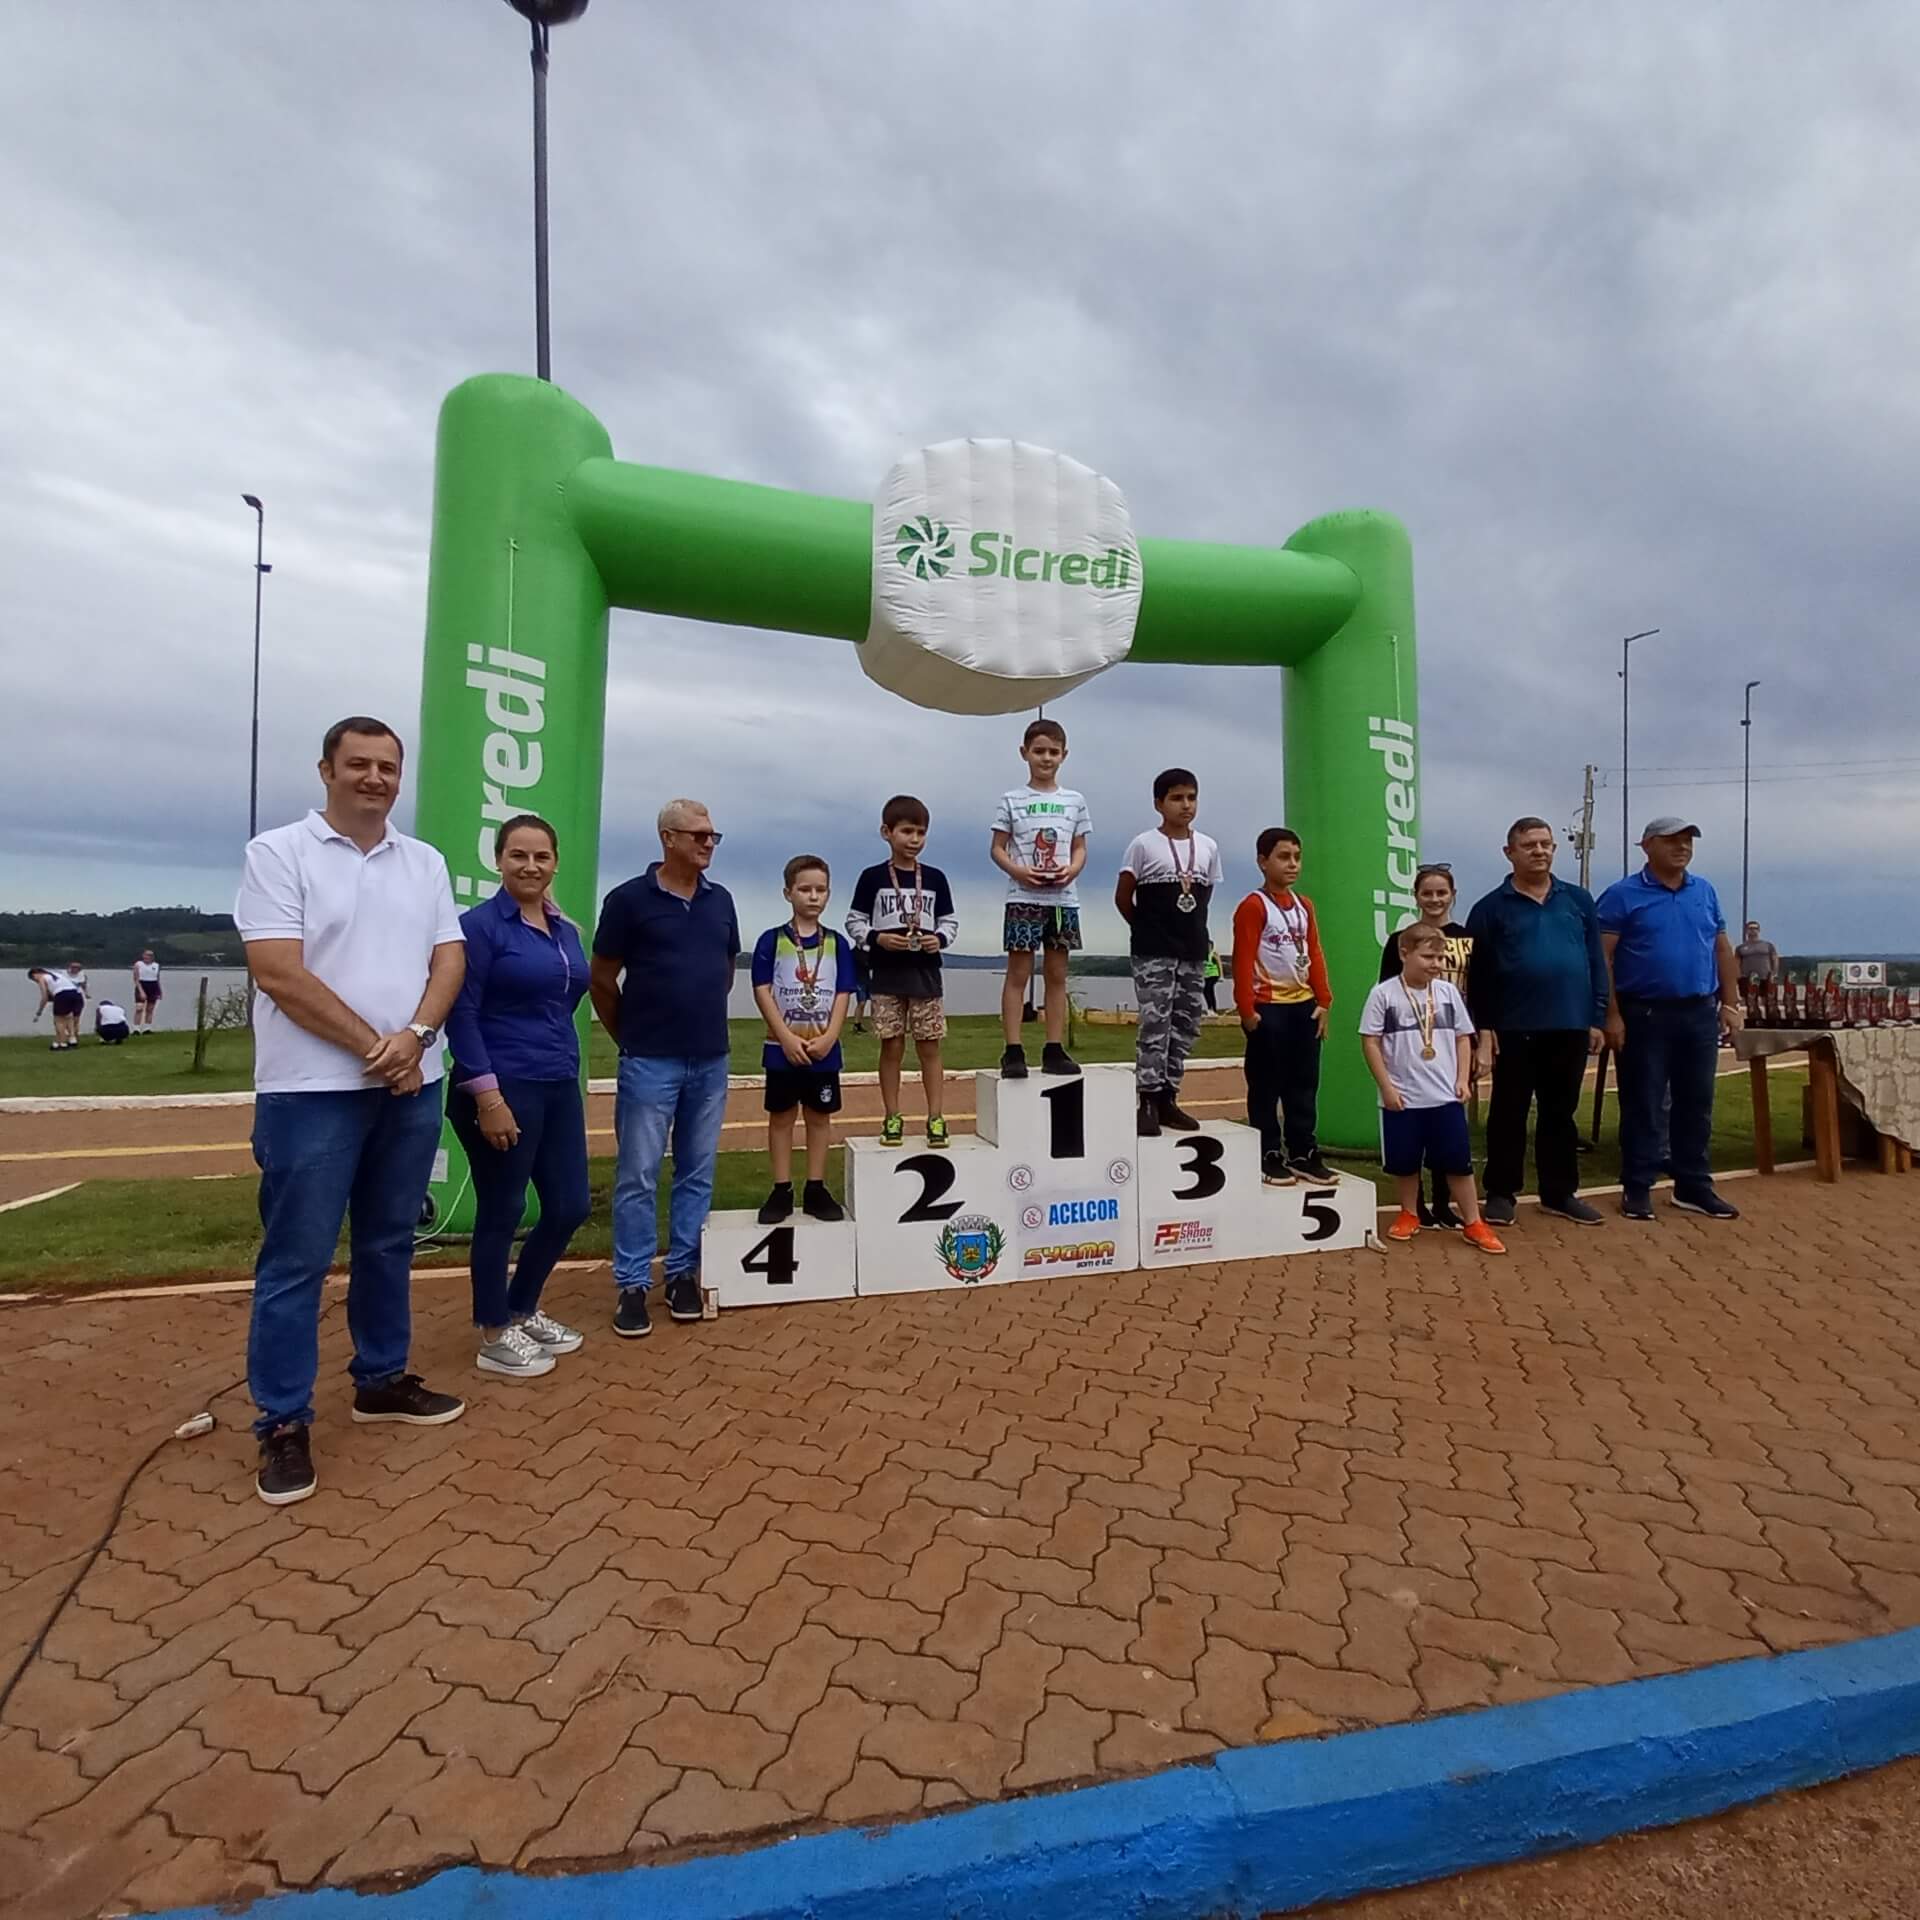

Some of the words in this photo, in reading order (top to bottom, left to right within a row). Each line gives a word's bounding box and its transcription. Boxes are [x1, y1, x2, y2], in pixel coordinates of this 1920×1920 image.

[968, 531, 1130, 589] Sicredi
[1040, 1077, 1085, 1158] 1
[893, 1154, 965, 1224] 2
[1172, 1135, 1226, 1200] 3
[1048, 1198, 1119, 1226] ACELCOR
[1300, 1189, 1341, 1241] 5
[740, 1226, 799, 1284] 4
